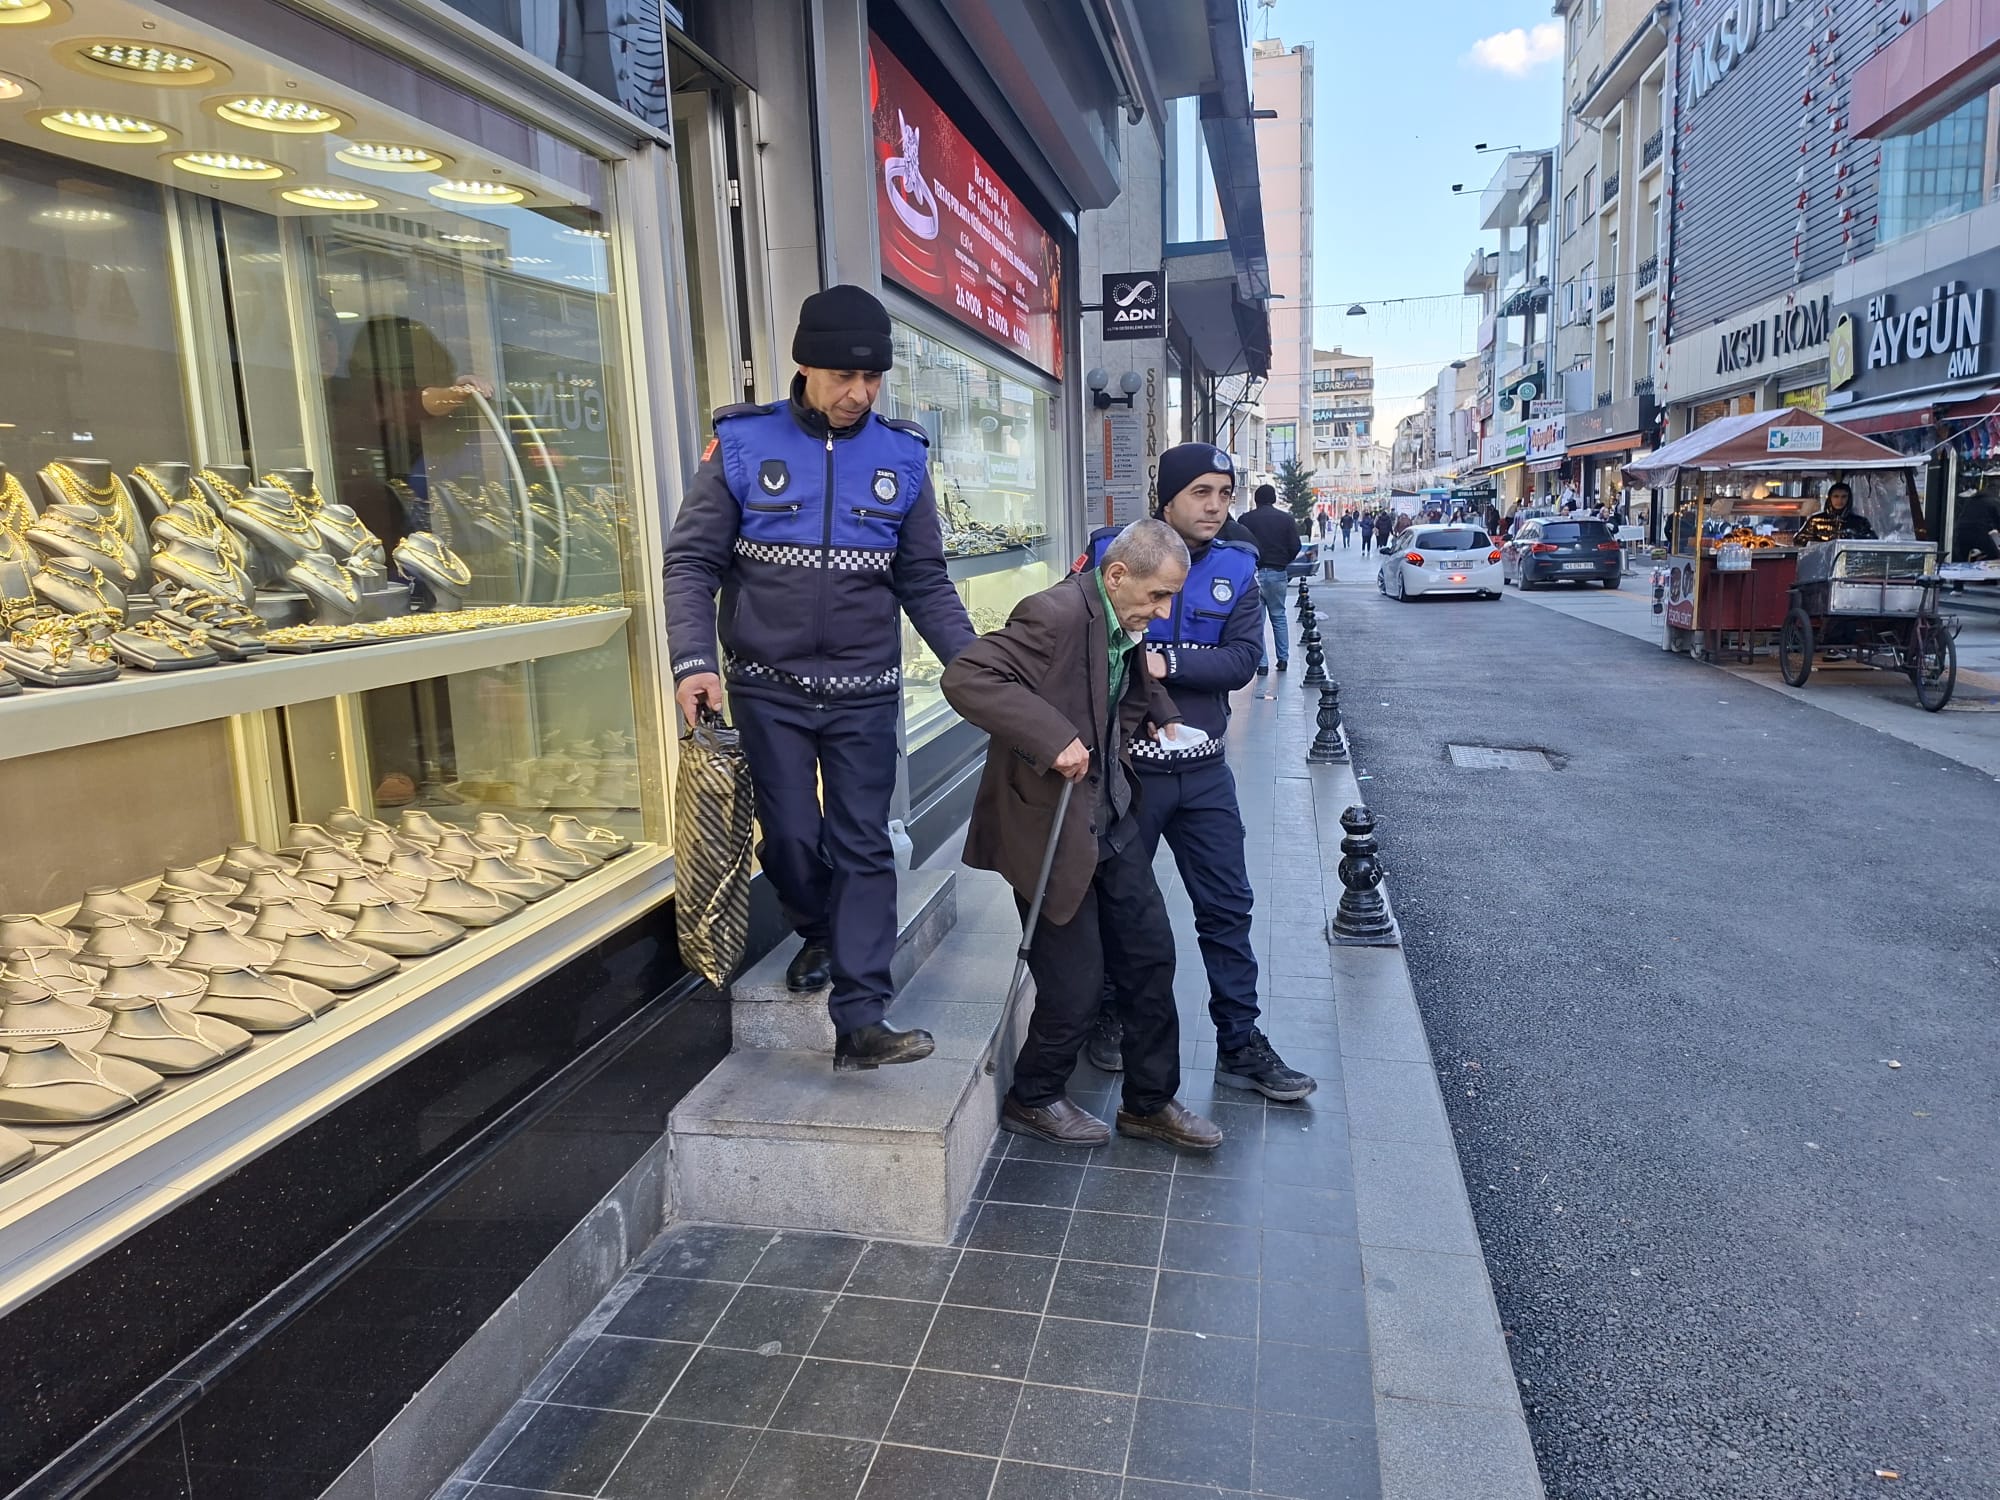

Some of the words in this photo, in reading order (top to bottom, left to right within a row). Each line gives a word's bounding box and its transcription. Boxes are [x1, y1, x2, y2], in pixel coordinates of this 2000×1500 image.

[1114, 308, 1155, 322] ADN
[1868, 294, 1888, 321] EN
[1716, 320, 1766, 375] AKSU
[1773, 295, 1830, 358] HOM
[1867, 280, 1988, 369] AYGÜN
[1947, 347, 1980, 379] AVM
[1146, 368, 1157, 457] SOYDAN
[877, 470, 895, 479] ZABITA
[674, 659, 706, 674] ZABITA
